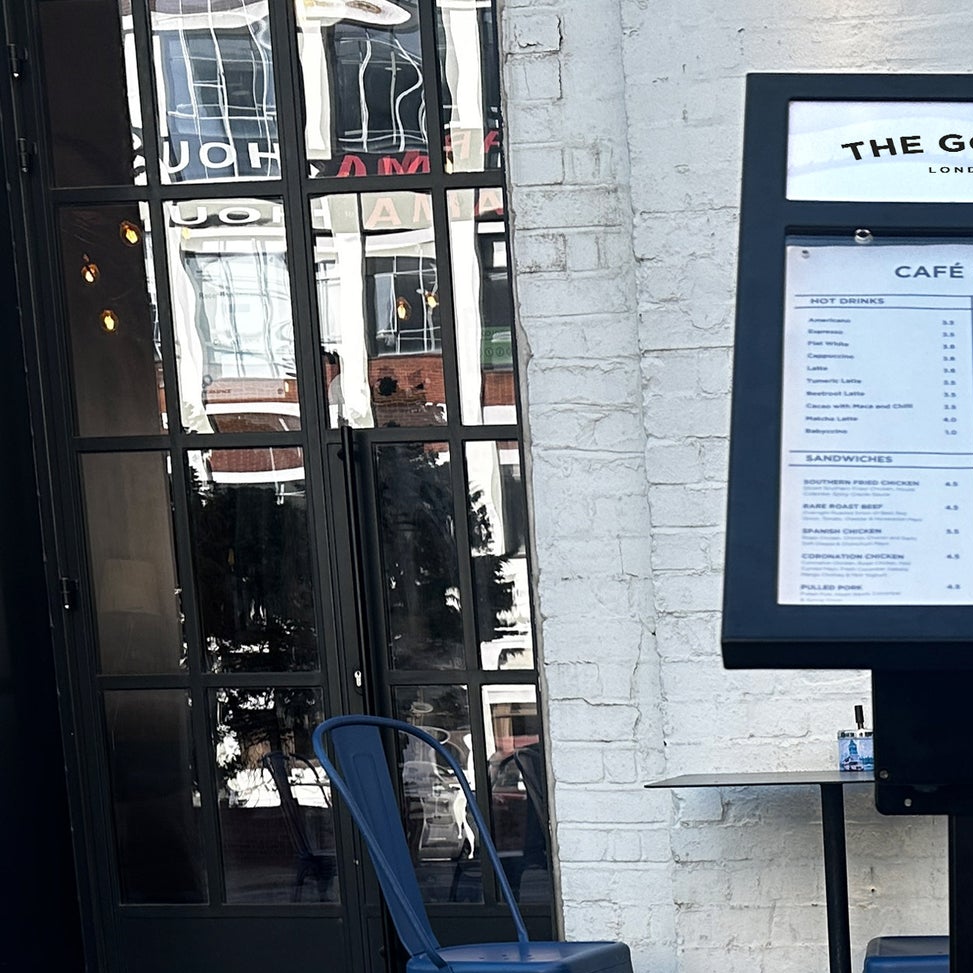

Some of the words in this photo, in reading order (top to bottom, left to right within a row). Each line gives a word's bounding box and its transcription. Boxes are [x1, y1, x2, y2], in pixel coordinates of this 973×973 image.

[841, 134, 924, 161] THE
[894, 262, 964, 279] CAFÉ
[806, 455, 893, 463] SANDWICHES
